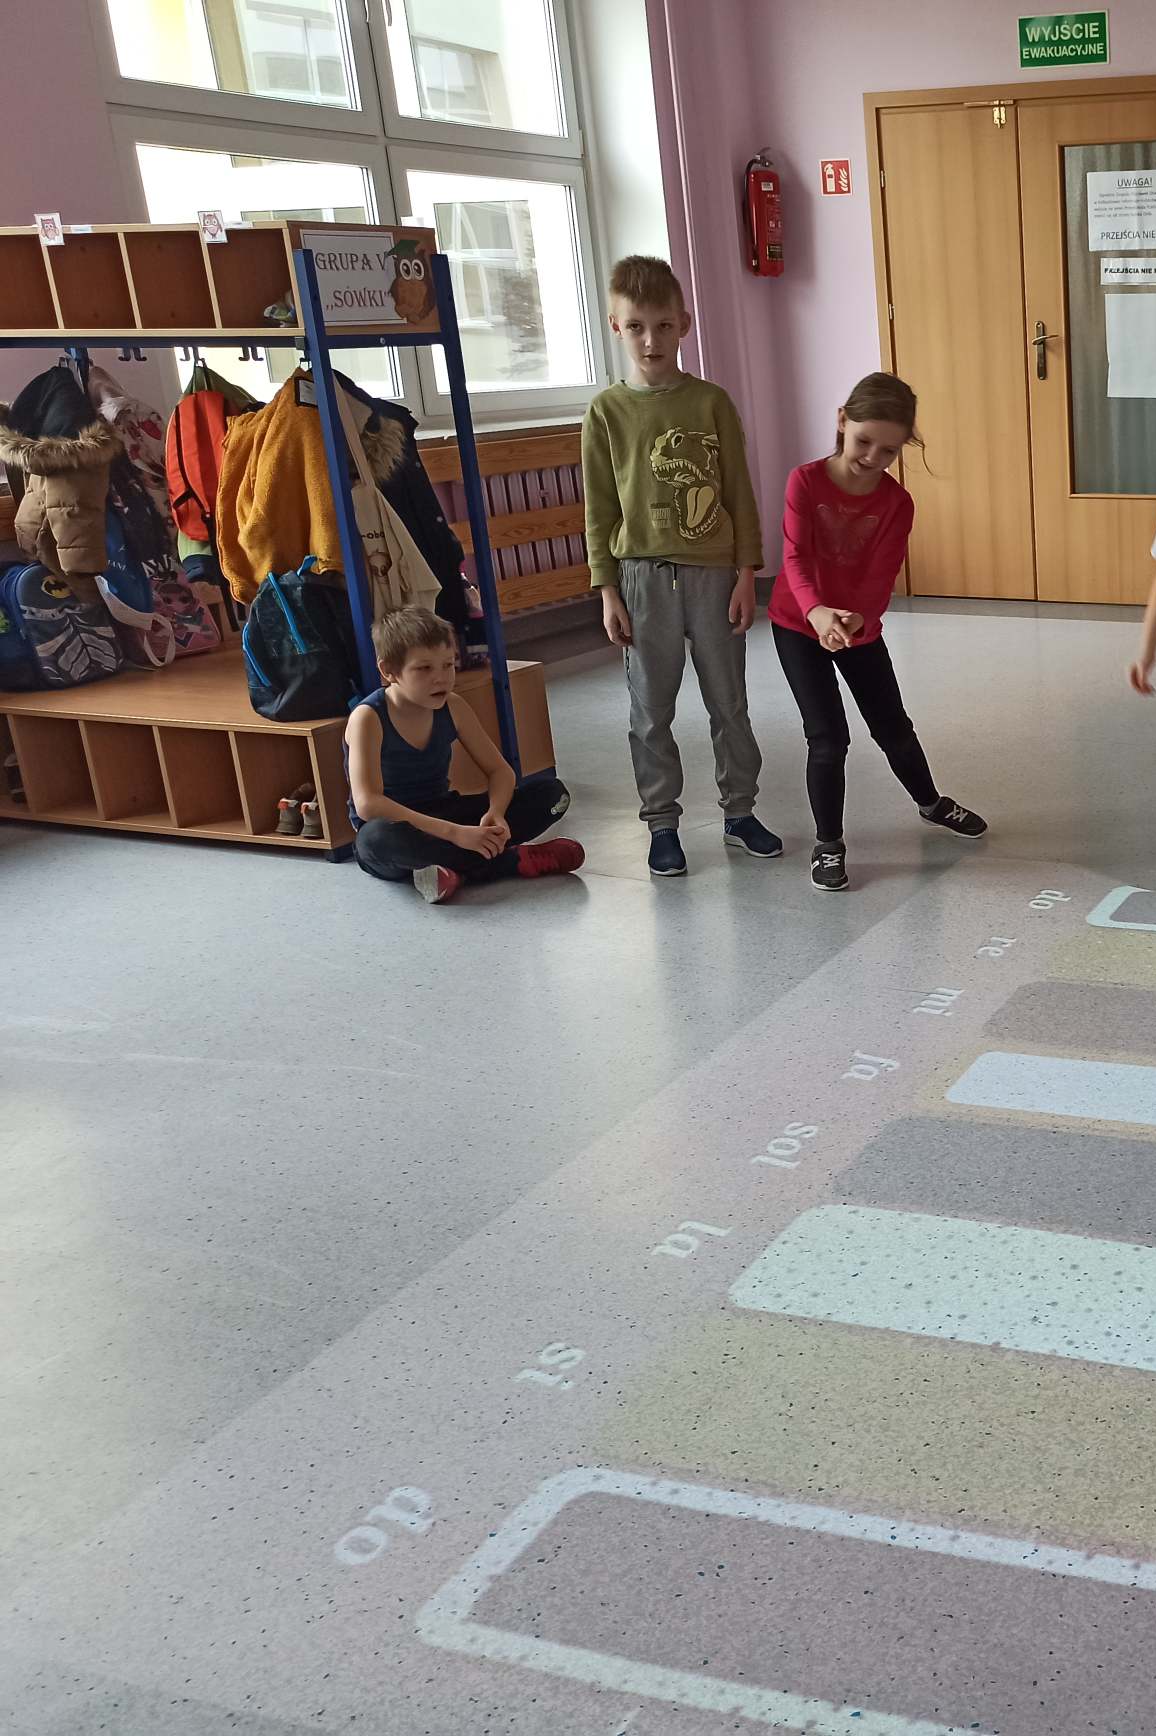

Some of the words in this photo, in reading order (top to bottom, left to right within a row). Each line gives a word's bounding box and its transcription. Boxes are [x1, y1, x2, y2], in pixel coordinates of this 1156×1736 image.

[1025, 20, 1099, 43] WYJŚCIE
[1022, 43, 1104, 59] EWAKUACYJNE
[1117, 177, 1153, 189] UWAGA!
[1101, 230, 1140, 240] PRZEJŚCIA
[1142, 230, 1156, 239] NIE
[315, 252, 373, 271] GRUPA
[1028, 889, 1071, 910] do
[977, 936, 1017, 956] re
[840, 1050, 900, 1081] fa
[750, 1121, 819, 1170] sol
[651, 1220, 733, 1258] la
[511, 1342, 586, 1391] si
[334, 1486, 434, 1566] do
